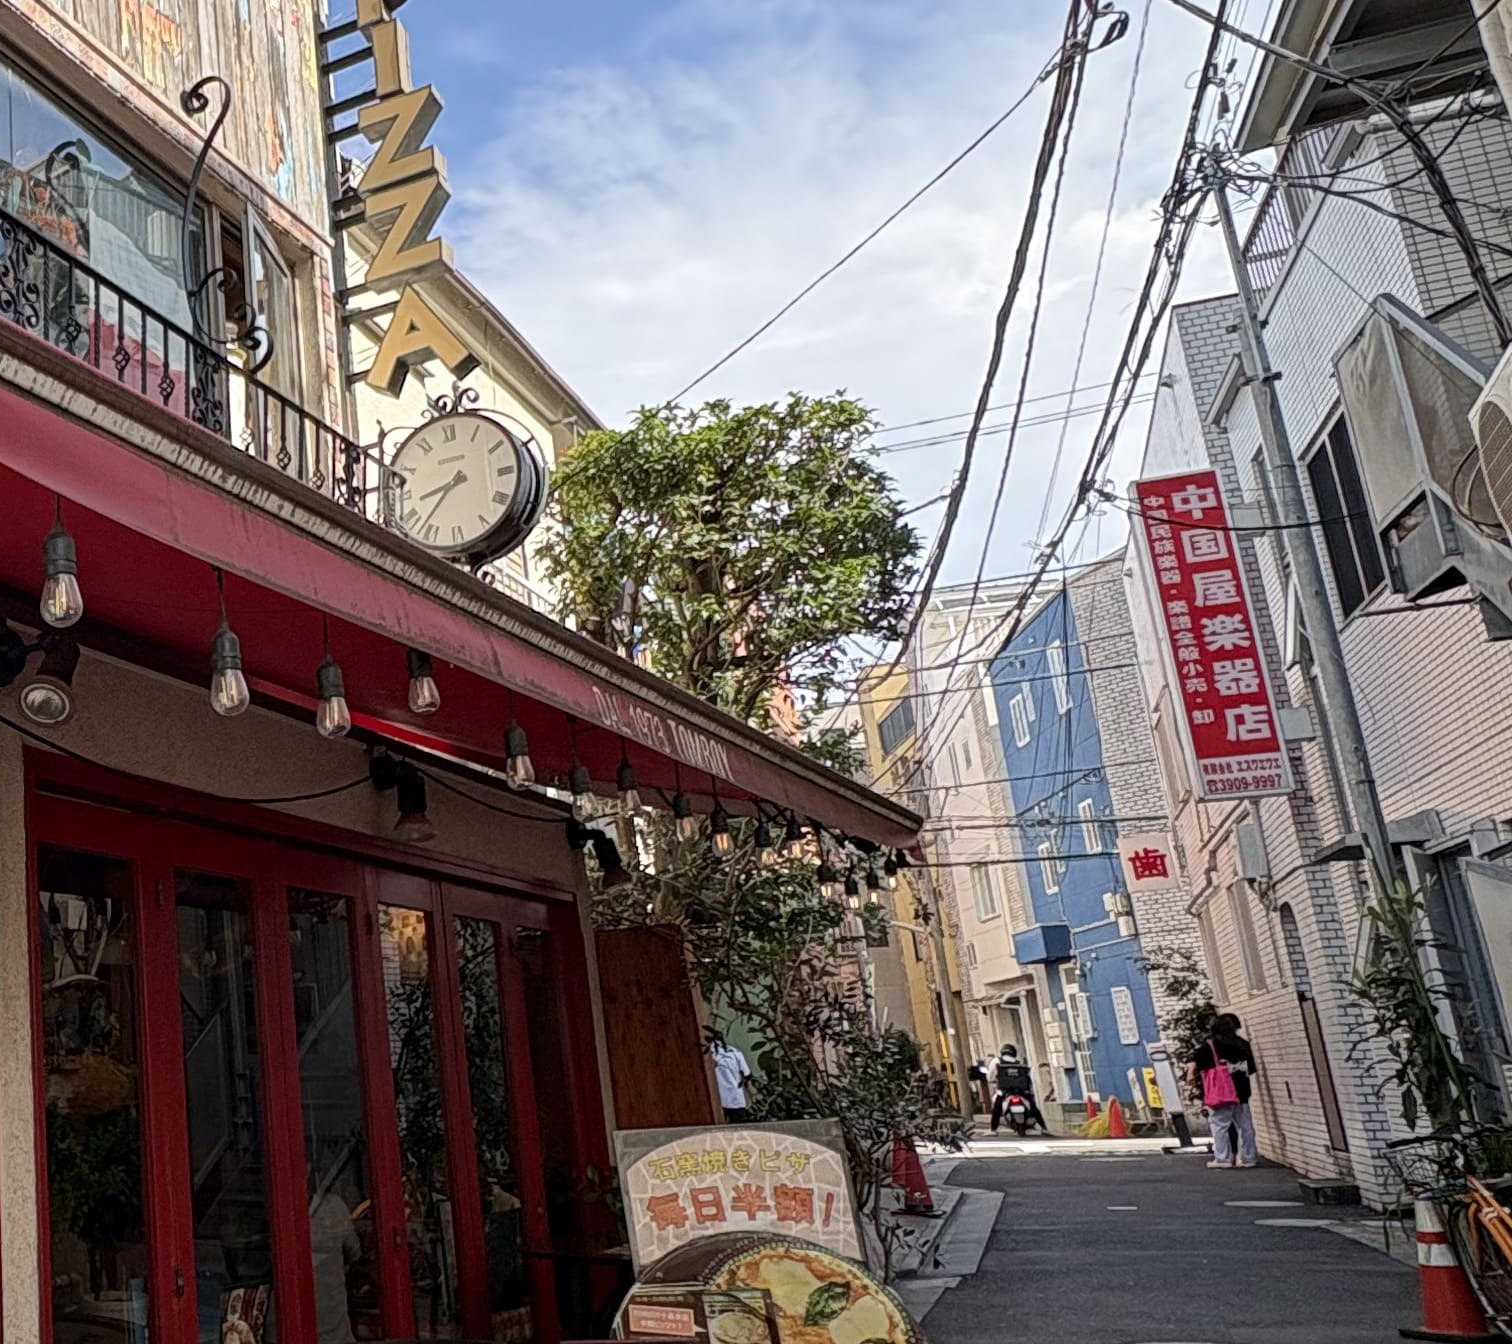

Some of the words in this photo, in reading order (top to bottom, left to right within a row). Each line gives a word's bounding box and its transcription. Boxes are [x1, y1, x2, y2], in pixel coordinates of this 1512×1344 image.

[1171, 484, 1273, 742] 中国屋楽器店
[629, 703, 670, 754] 1973
[667, 719, 735, 793] TOMBOY
[1218, 773, 1282, 792] 3909-9997
[1128, 847, 1168, 880] 歯
[648, 1149, 811, 1182] 石窯焼きピザ
